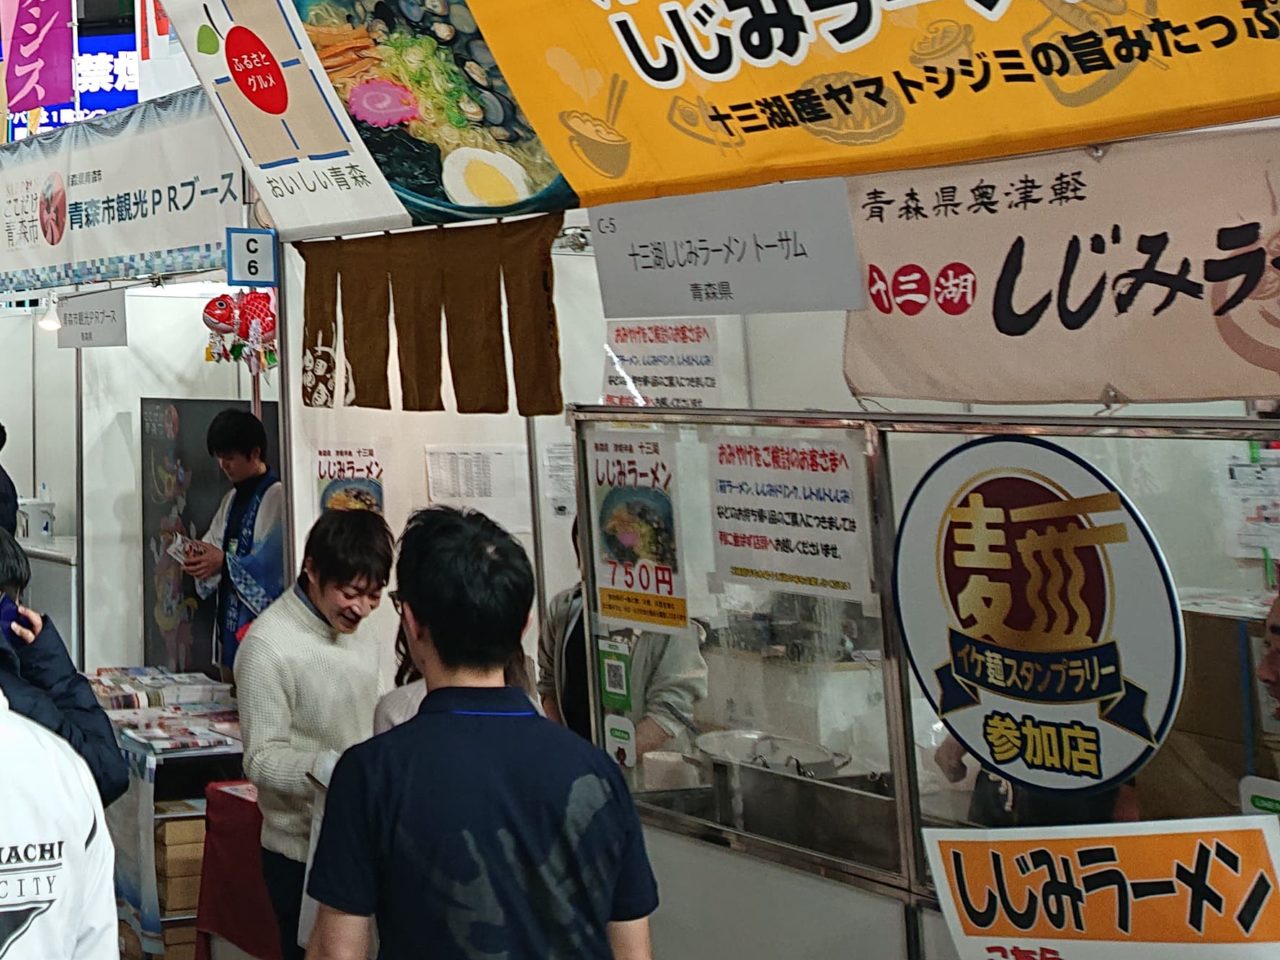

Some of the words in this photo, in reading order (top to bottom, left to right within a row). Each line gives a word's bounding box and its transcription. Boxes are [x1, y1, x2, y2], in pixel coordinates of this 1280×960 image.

[231, 51, 270, 72] ふるさと
[247, 75, 277, 92] グルメ
[266, 163, 372, 198] おいしい青森
[861, 171, 1088, 223] 青森県奥津軽
[597, 217, 617, 234] C-5
[246, 238, 259, 254] C
[628, 234, 748, 271] 十三湖しじみラーメン
[753, 230, 810, 263] トーサム
[247, 259, 259, 276] 6
[992, 222, 1280, 337] しじみラ
[689, 281, 734, 303] 青森県
[870, 270, 975, 308] 十三湖
[317, 459, 384, 480] しじみラーメン
[595, 458, 673, 492] しじみラーメン
[608, 559, 675, 596] 750円
[986, 714, 1100, 776] 参加店
[950, 838, 1273, 936] しじみラーメン
